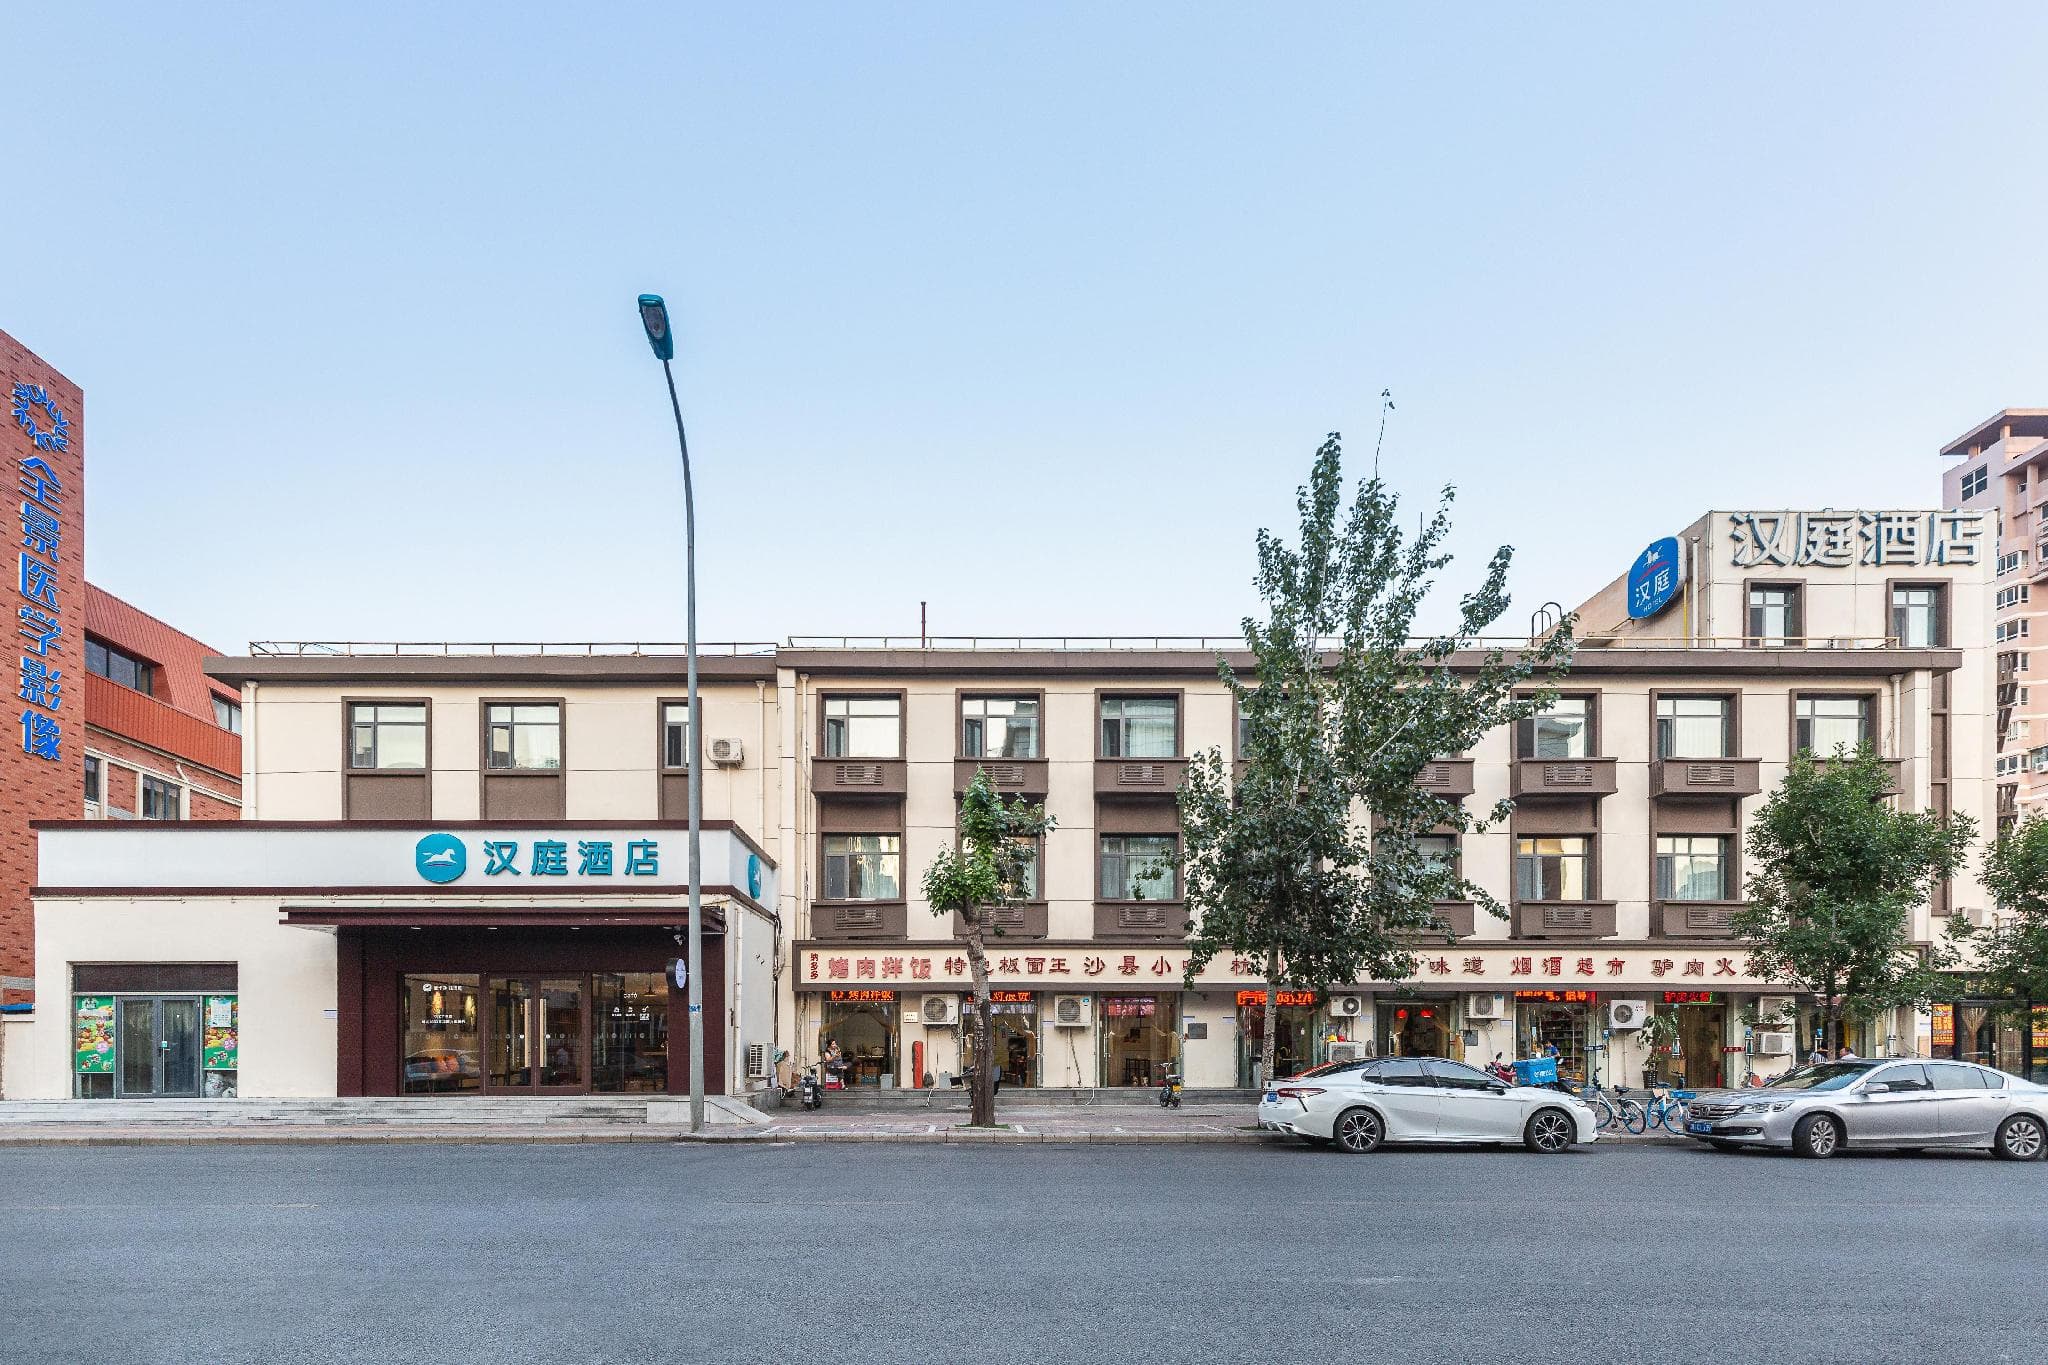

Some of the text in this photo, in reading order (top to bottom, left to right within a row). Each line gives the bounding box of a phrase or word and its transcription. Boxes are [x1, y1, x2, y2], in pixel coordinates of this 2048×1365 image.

[1729, 508, 1983, 567] 汉庭酒店
[1635, 567, 1670, 607] 汉庭
[1643, 596, 1663, 612] HOTEL
[18, 455, 62, 761] 全景医学影像
[483, 838, 658, 876] 汉庭酒店
[828, 957, 932, 979] 烤肉拌饭
[1511, 956, 1625, 976] 烟酒超市
